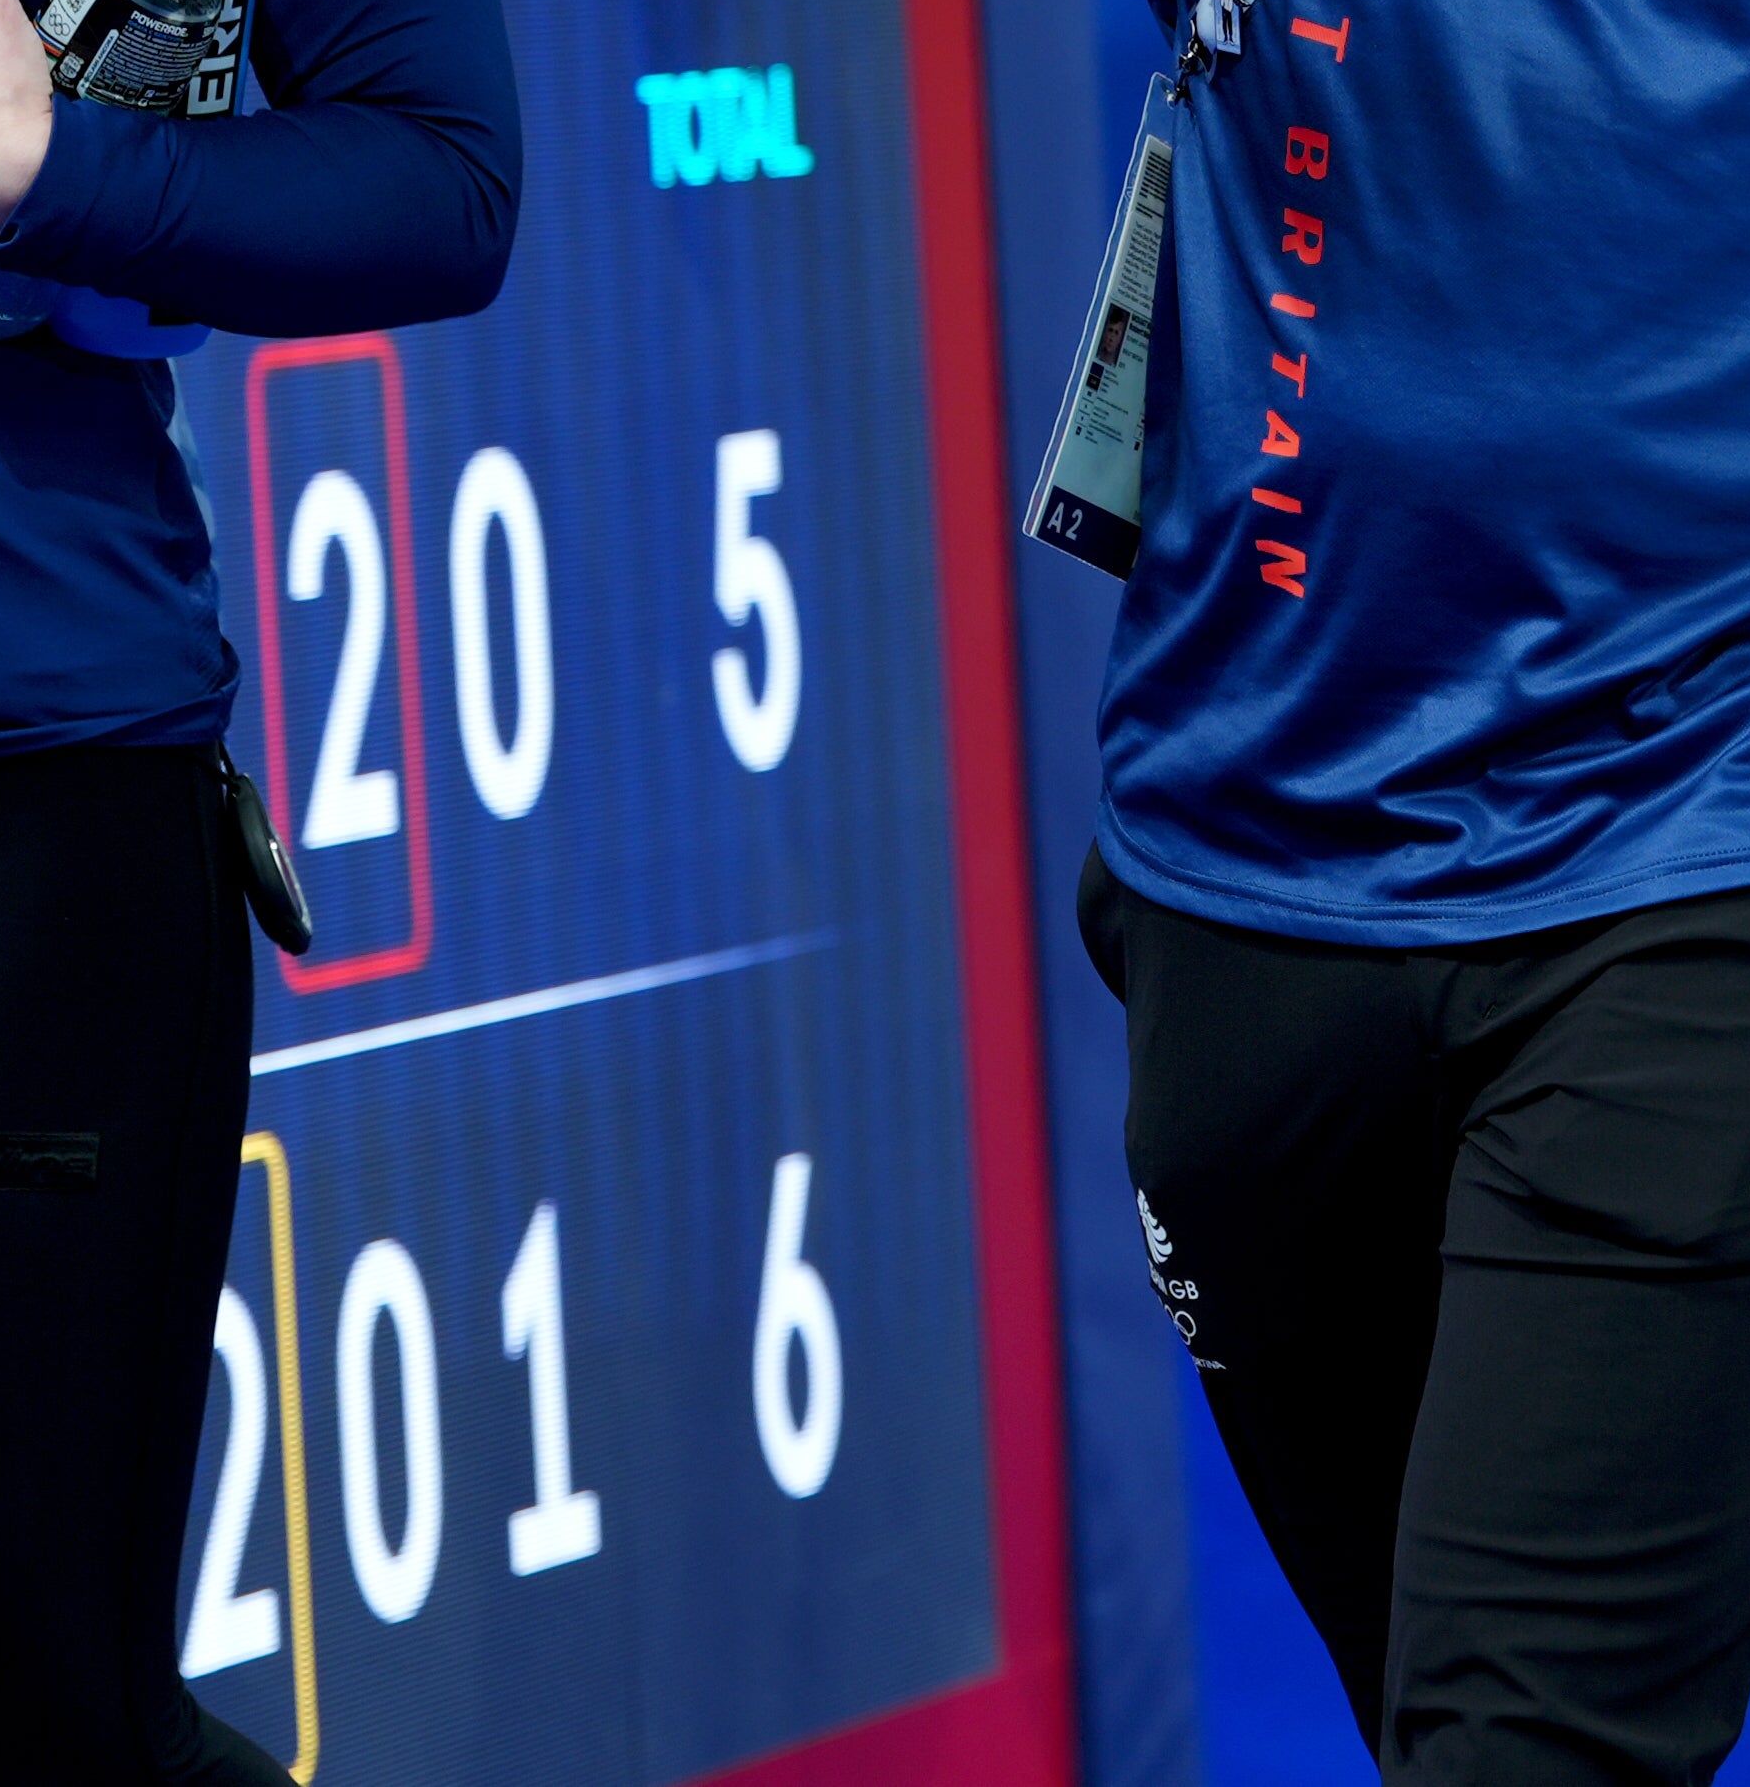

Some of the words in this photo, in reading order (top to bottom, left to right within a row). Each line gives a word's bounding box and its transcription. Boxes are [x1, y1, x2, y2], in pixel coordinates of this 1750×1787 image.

[130, 10, 189, 37] POWERADE
[636, 62, 815, 189] TOTAL
[1251, 125, 1329, 599] BRITAIN
[288, 469, 399, 849] 2
[450, 447, 554, 820] 0
[710, 428, 800, 772] 5
[178, 1284, 280, 1678] 2
[336, 1239, 444, 1623] 0
[501, 1198, 601, 1576] 1
[753, 1152, 843, 1498] 6
[1168, 1279, 1199, 1300] GB
